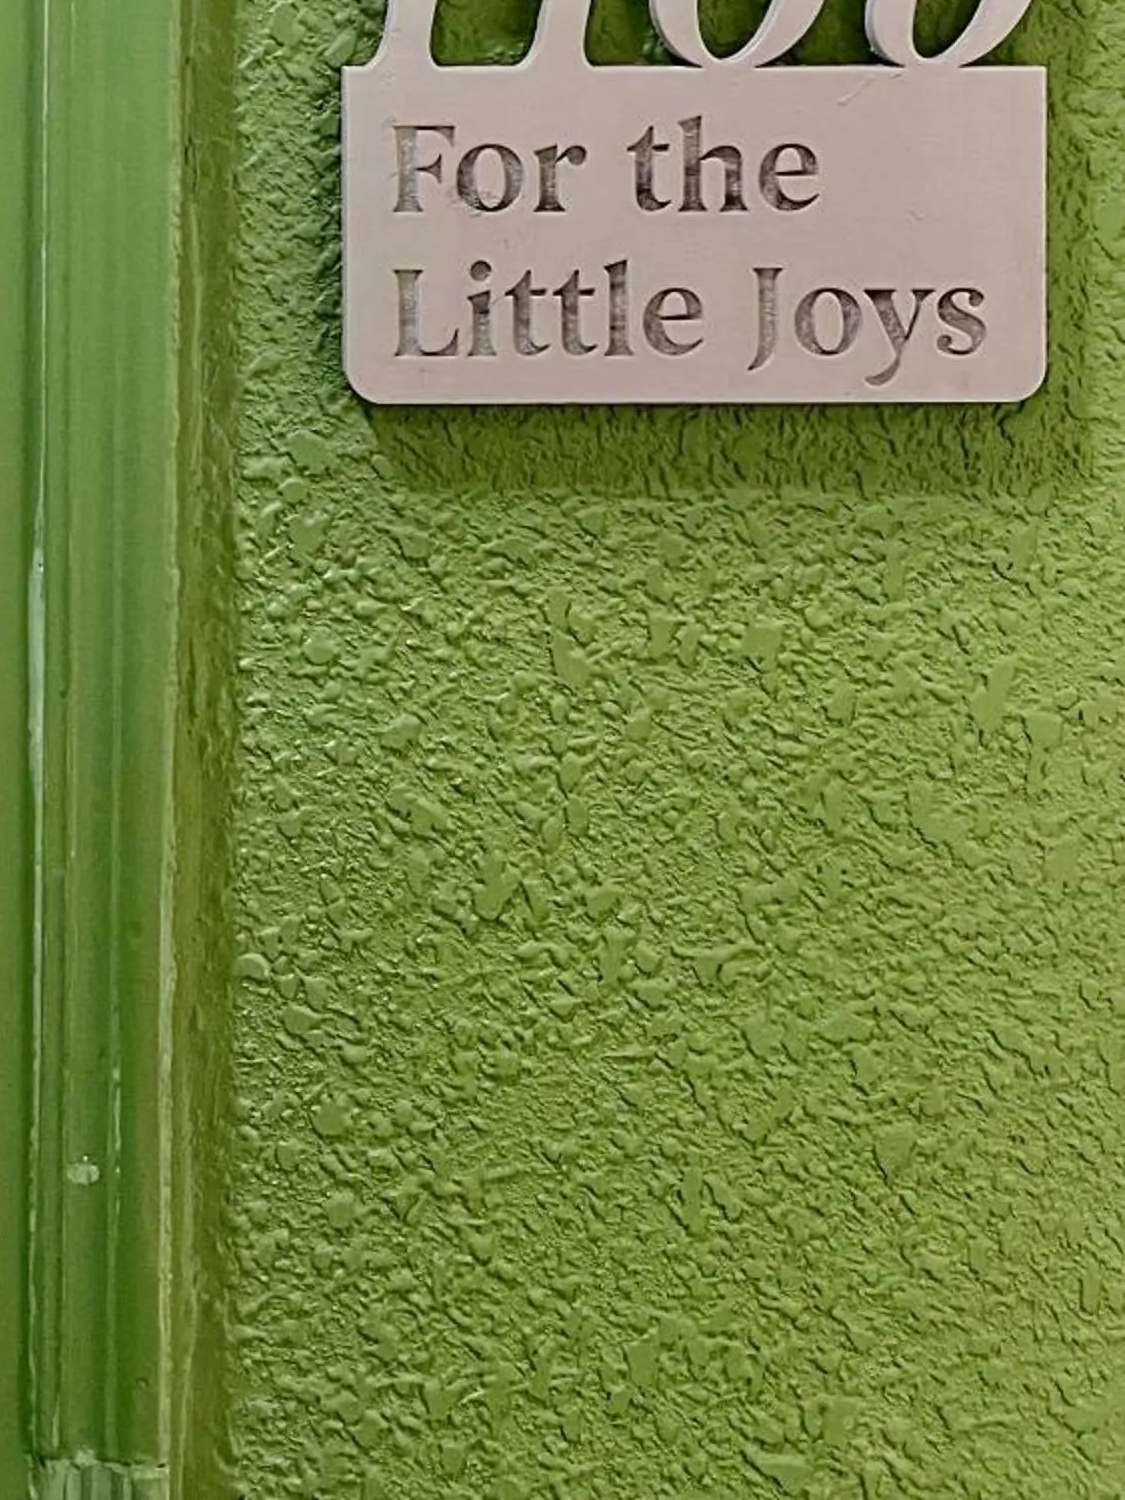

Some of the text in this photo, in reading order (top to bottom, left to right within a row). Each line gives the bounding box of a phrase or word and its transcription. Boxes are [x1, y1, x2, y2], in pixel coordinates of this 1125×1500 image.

[390, 115, 821, 213] For the
[392, 258, 988, 385] Little Joys
